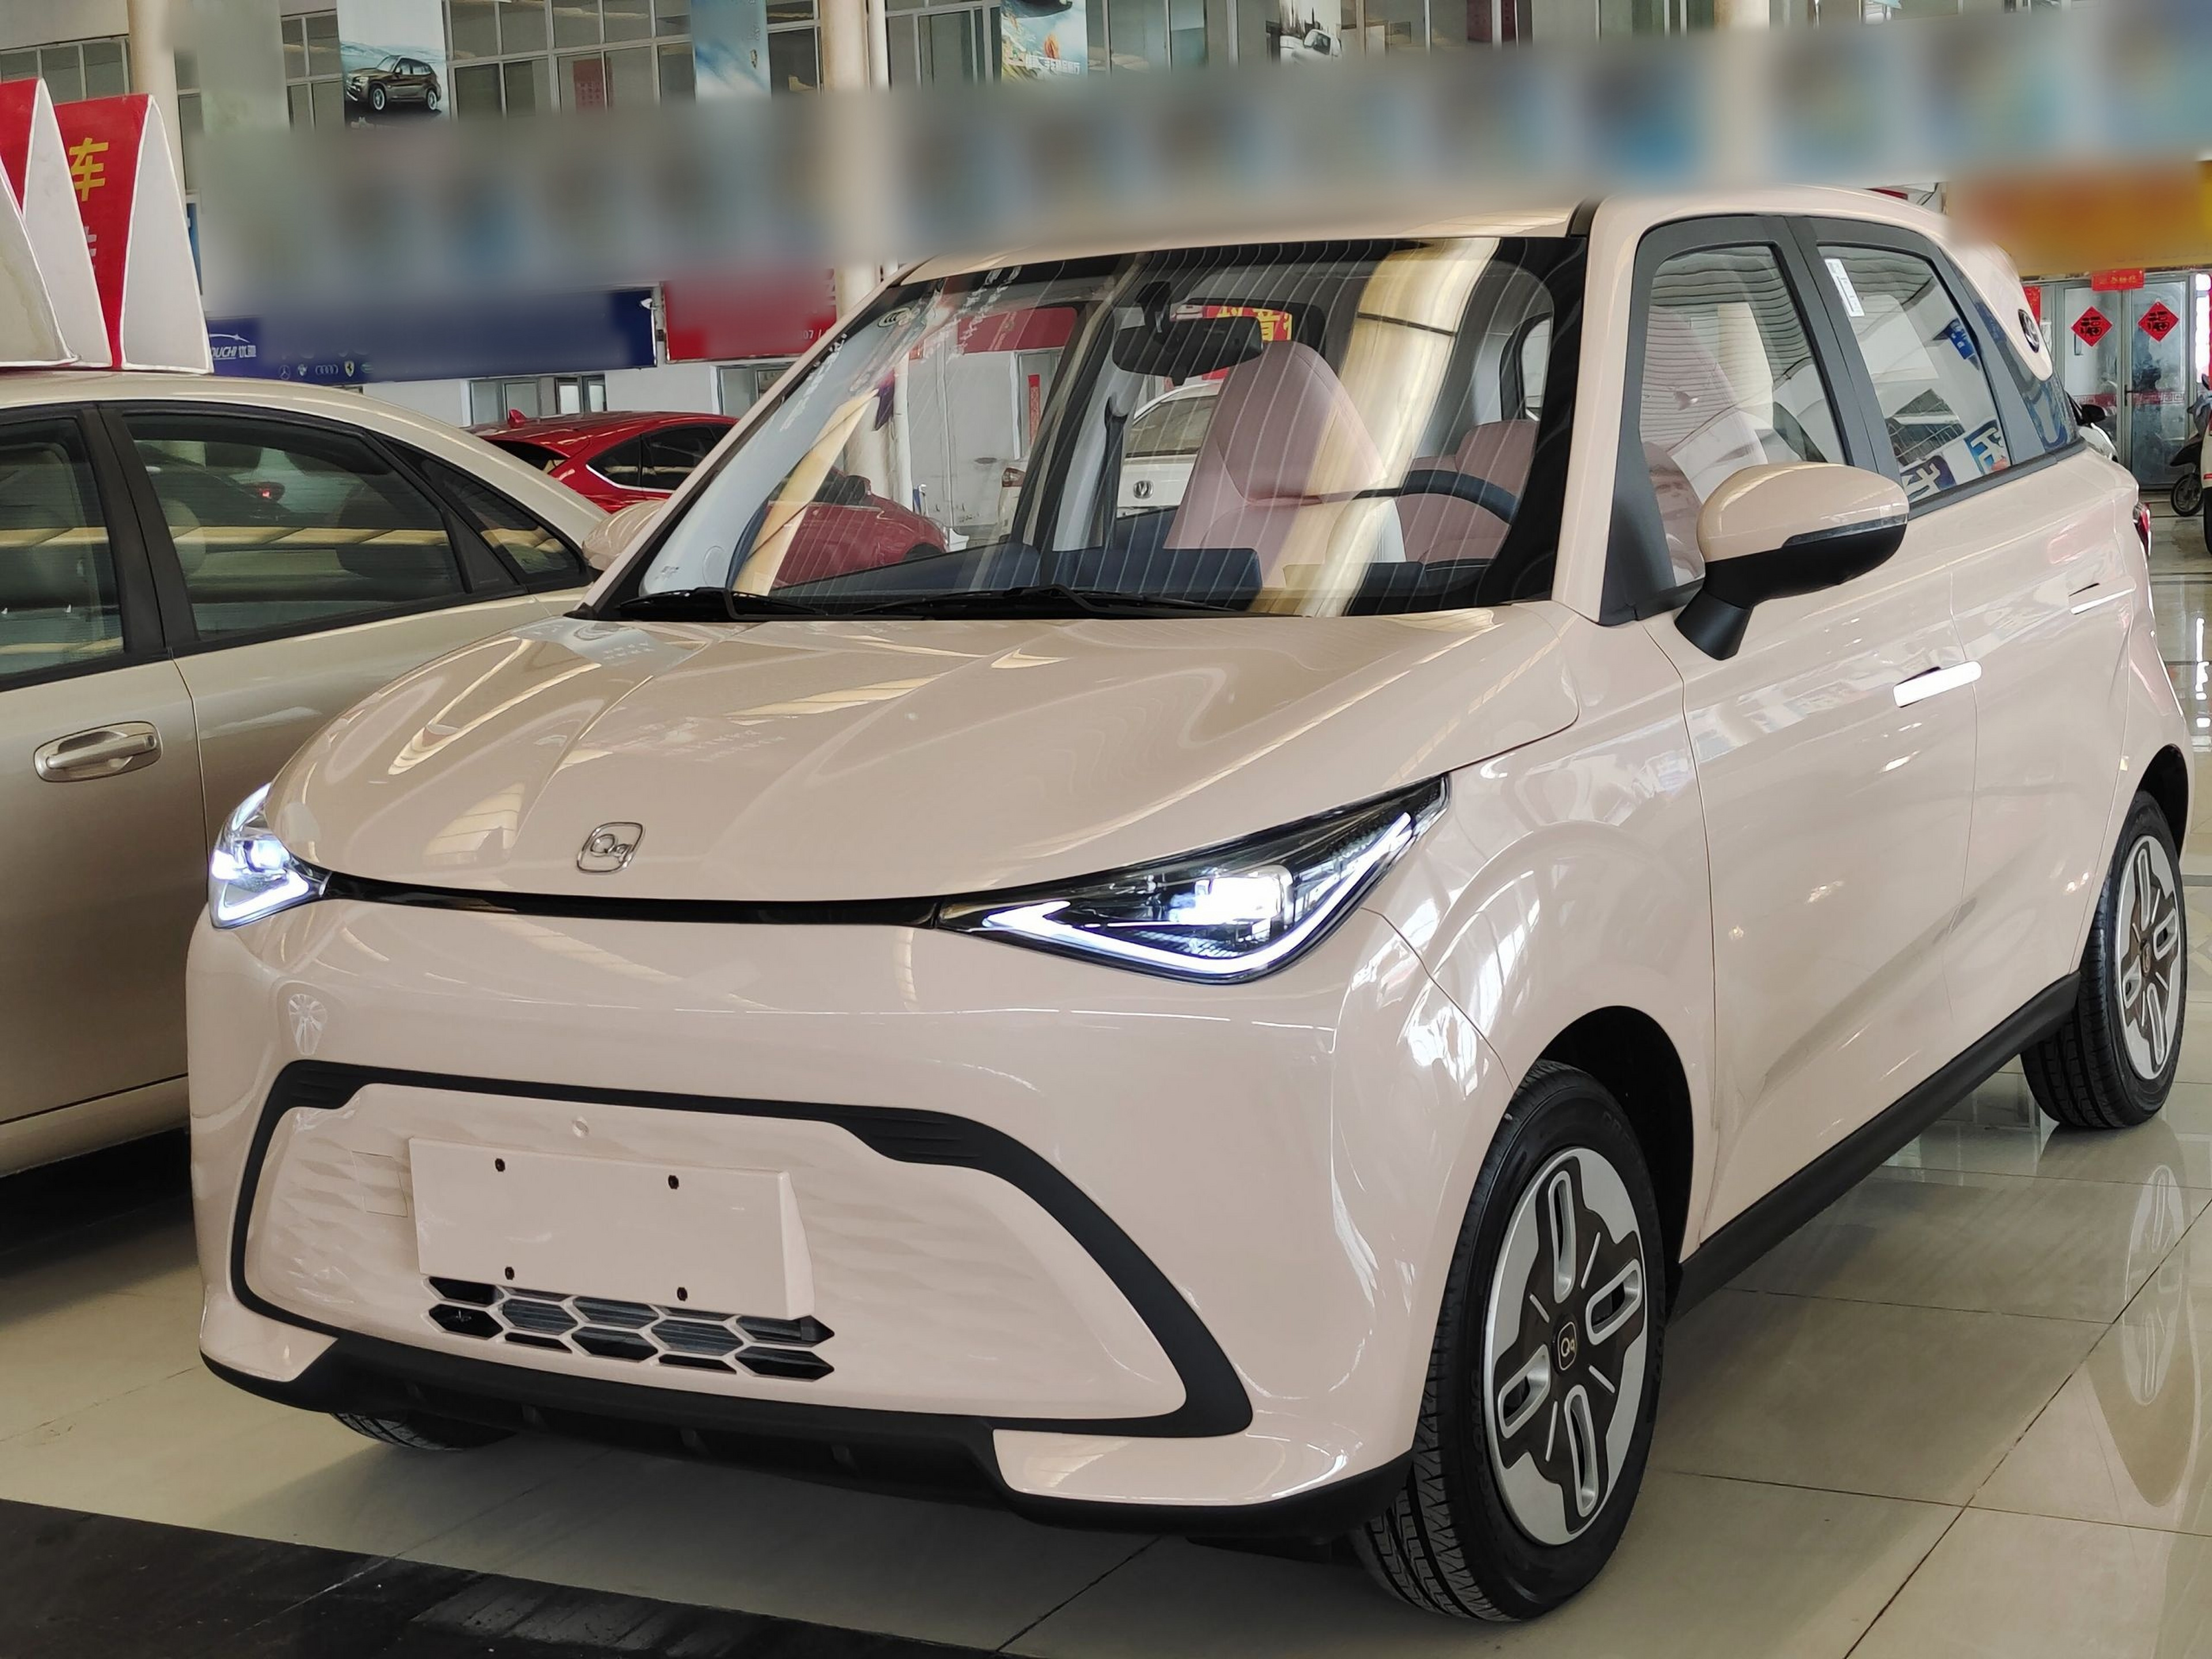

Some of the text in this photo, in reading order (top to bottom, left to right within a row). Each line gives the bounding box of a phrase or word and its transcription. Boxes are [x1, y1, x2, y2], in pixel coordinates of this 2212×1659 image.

[69, 137, 109, 202] 车
[2080, 316, 2102, 336] 福
[2146, 310, 2169, 332] 福
